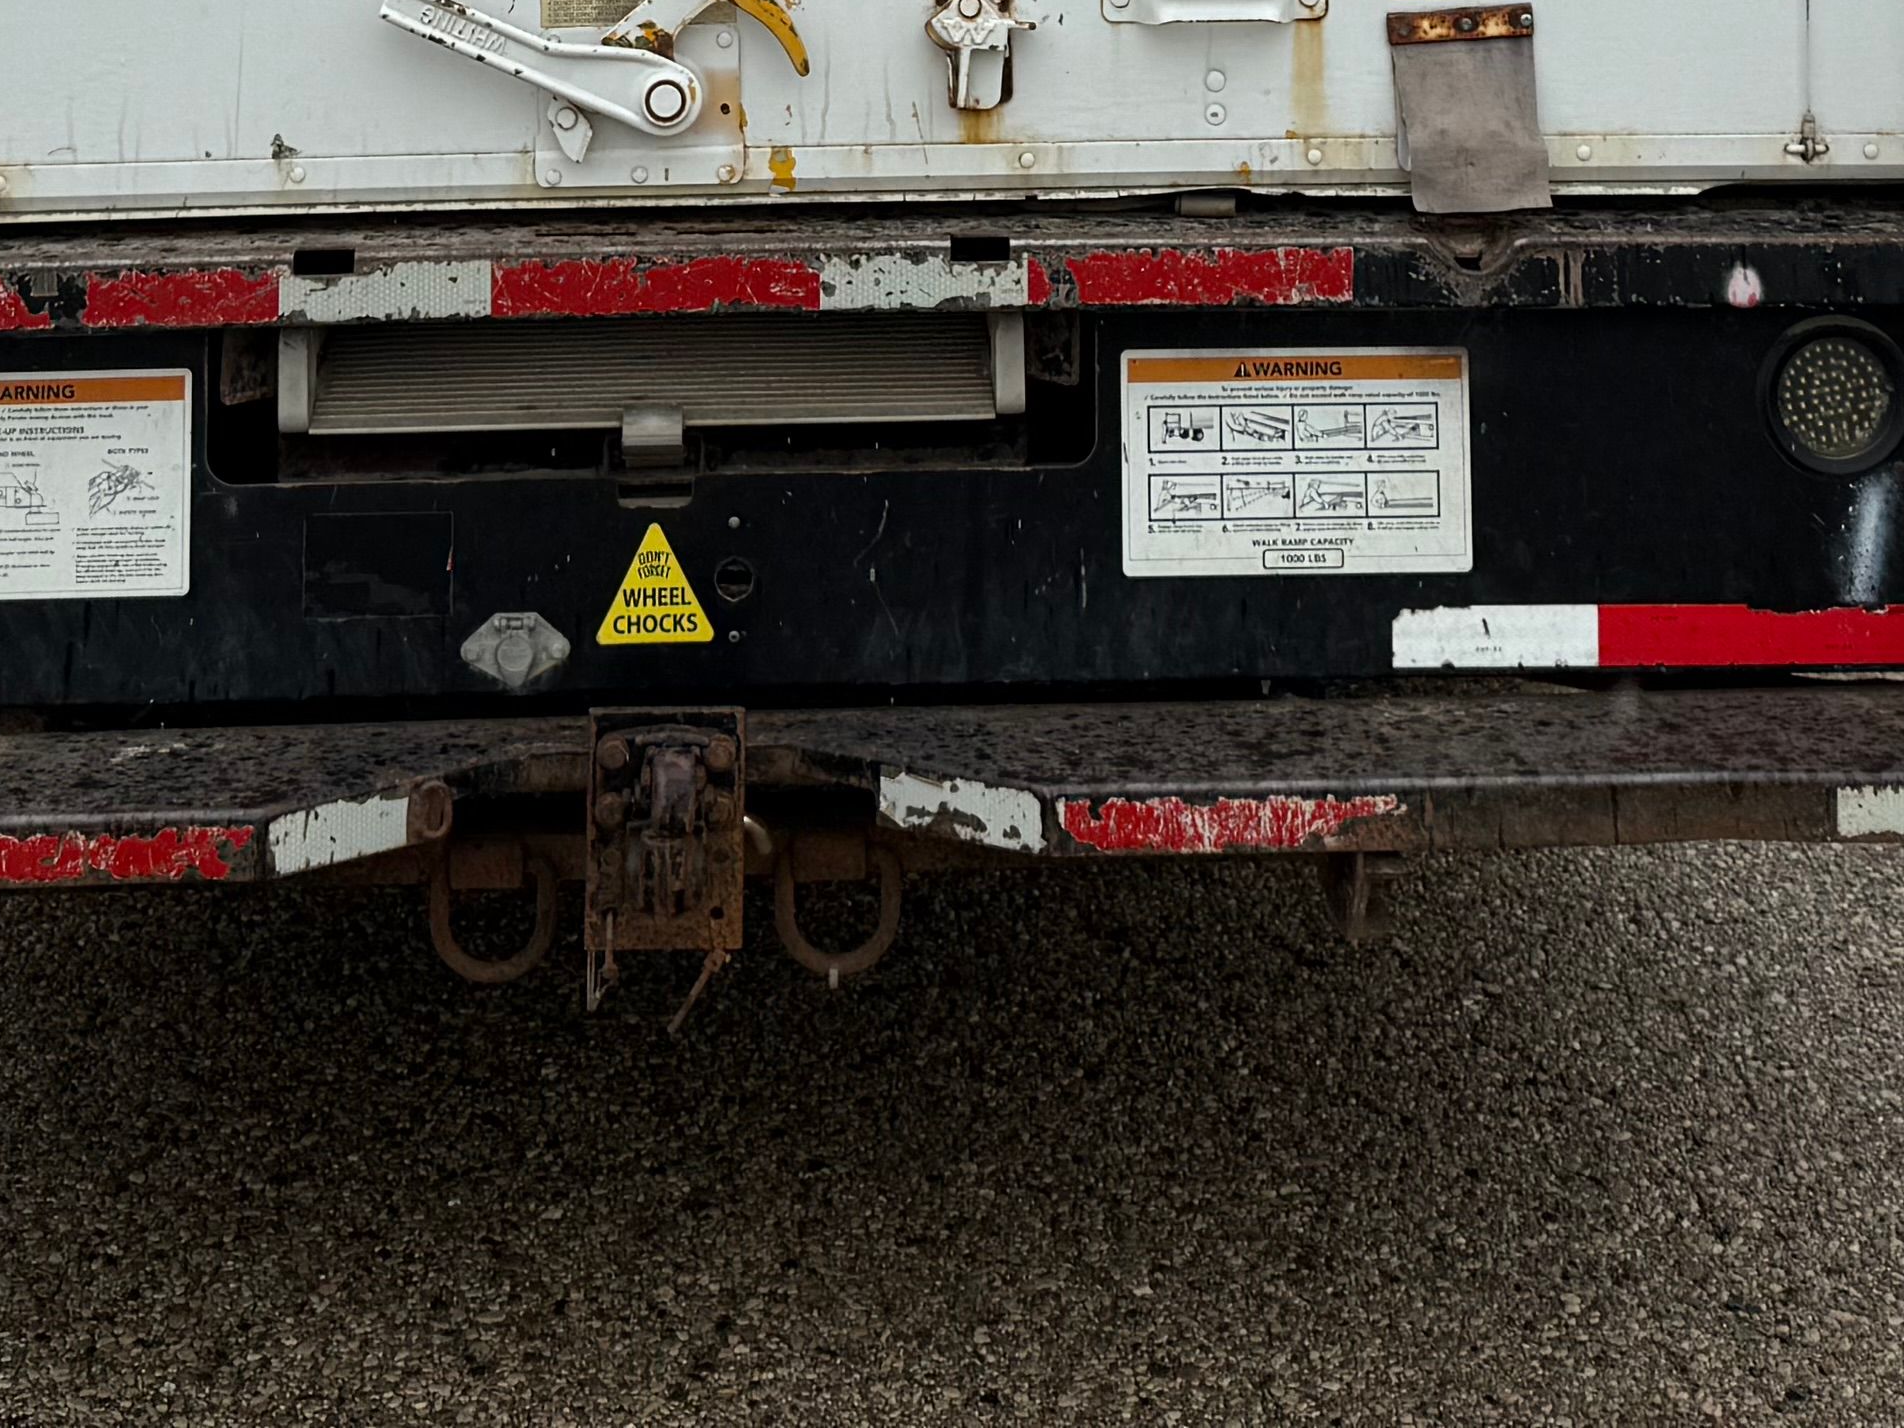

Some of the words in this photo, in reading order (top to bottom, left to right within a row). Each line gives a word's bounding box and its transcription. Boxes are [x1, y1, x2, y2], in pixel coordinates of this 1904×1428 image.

[420, 5, 509, 57] WHITING
[1252, 361, 1342, 377] WARNING
[1281, 554, 1305, 563] 1000
[622, 586, 692, 608] WHEEL
[612, 613, 699, 635] CHOCKS
